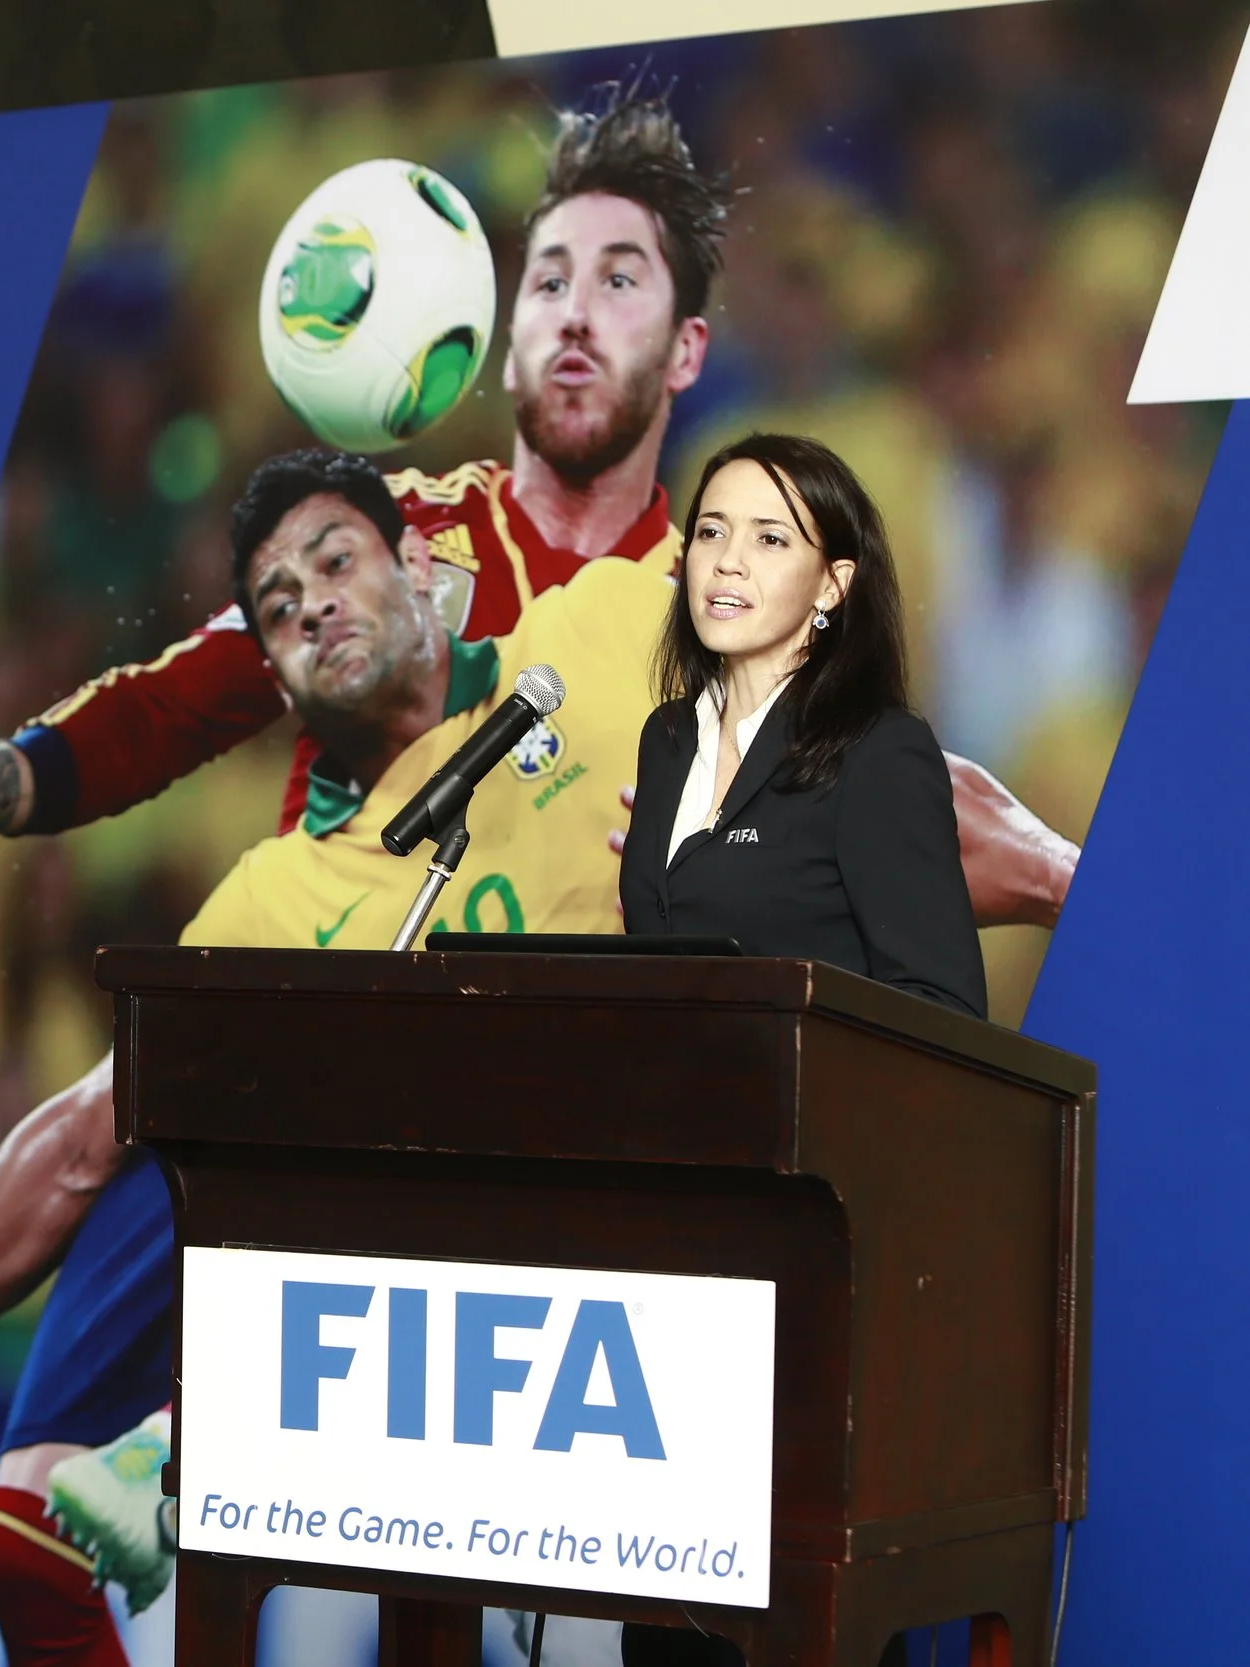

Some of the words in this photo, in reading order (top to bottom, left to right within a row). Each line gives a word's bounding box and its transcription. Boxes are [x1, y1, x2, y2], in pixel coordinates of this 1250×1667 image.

[533, 762, 588, 811] BRASIL
[726, 828, 759, 844] FIFA
[280, 1281, 667, 1460] FIFA
[200, 1494, 258, 1530] For
[266, 1499, 327, 1537] the
[338, 1507, 453, 1550] Game.
[467, 1519, 529, 1556] For
[538, 1525, 602, 1564] the
[617, 1532, 744, 1579] World.
